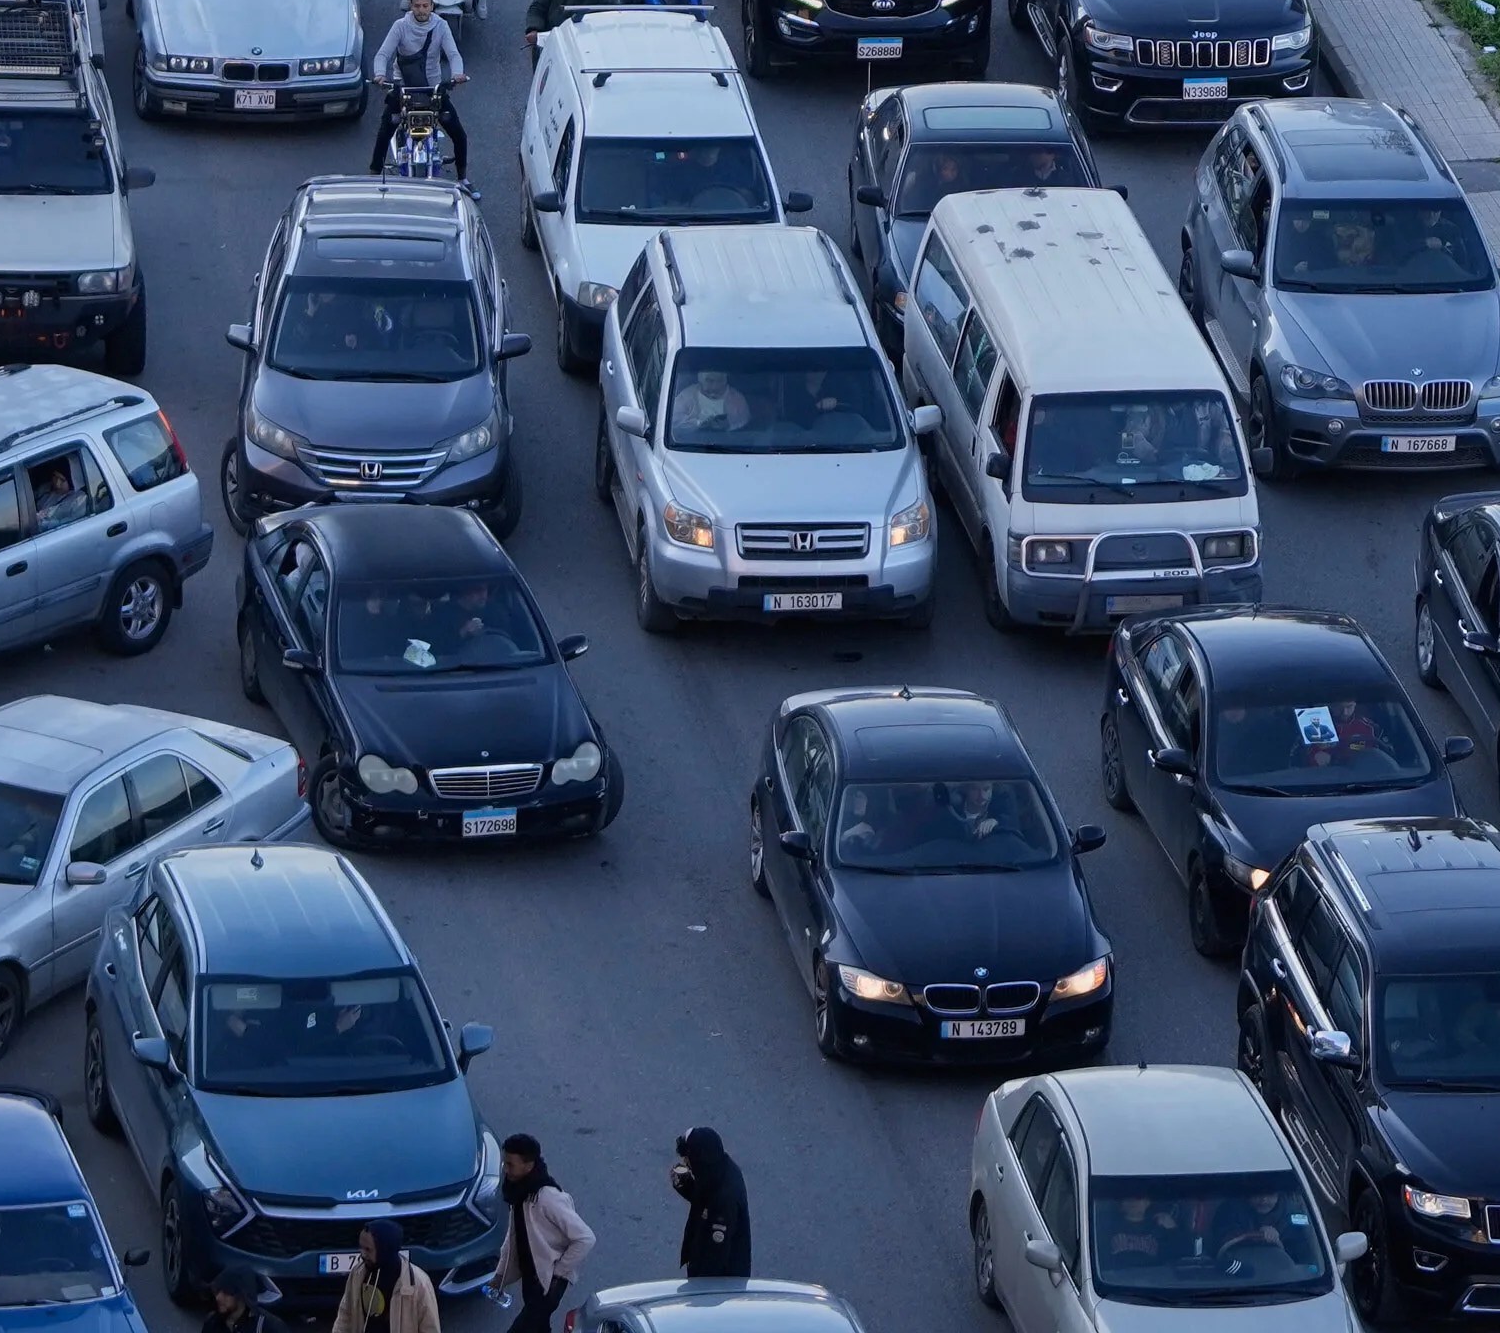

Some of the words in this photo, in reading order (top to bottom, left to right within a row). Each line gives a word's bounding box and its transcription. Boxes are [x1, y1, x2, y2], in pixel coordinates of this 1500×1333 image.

[1192, 30, 1218, 40] Jeep
[857, 45, 902, 58] S268880
[1183, 85, 1228, 99] N339688
[236, 93, 256, 105] K71
[1391, 439, 1399, 451] N
[1407, 437, 1448, 451] 167668
[1162, 569, 1190, 578] 200
[773, 597, 782, 608] N
[790, 595, 833, 608] 163017
[464, 819, 516, 834] S172698
[951, 1024, 960, 1037] N
[969, 1022, 1017, 1036] 143789
[330, 1258, 339, 1270] B
